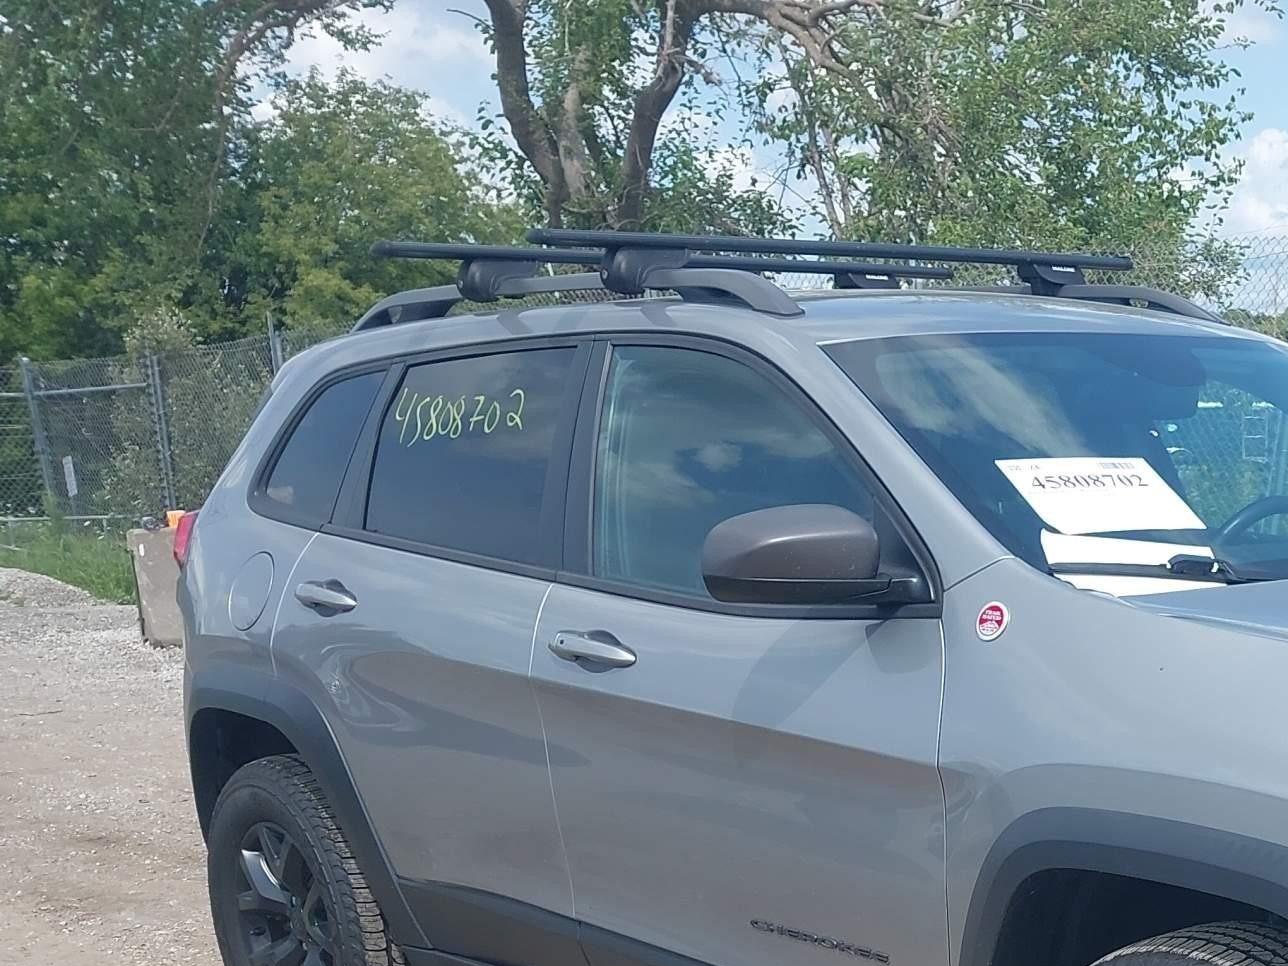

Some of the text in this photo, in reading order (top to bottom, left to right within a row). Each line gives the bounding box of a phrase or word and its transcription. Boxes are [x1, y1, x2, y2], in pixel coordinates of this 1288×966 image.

[395, 387, 525, 448] 45808702
[1031, 474, 1149, 489] 45808702
[749, 919, 891, 966] CHEROKEE
